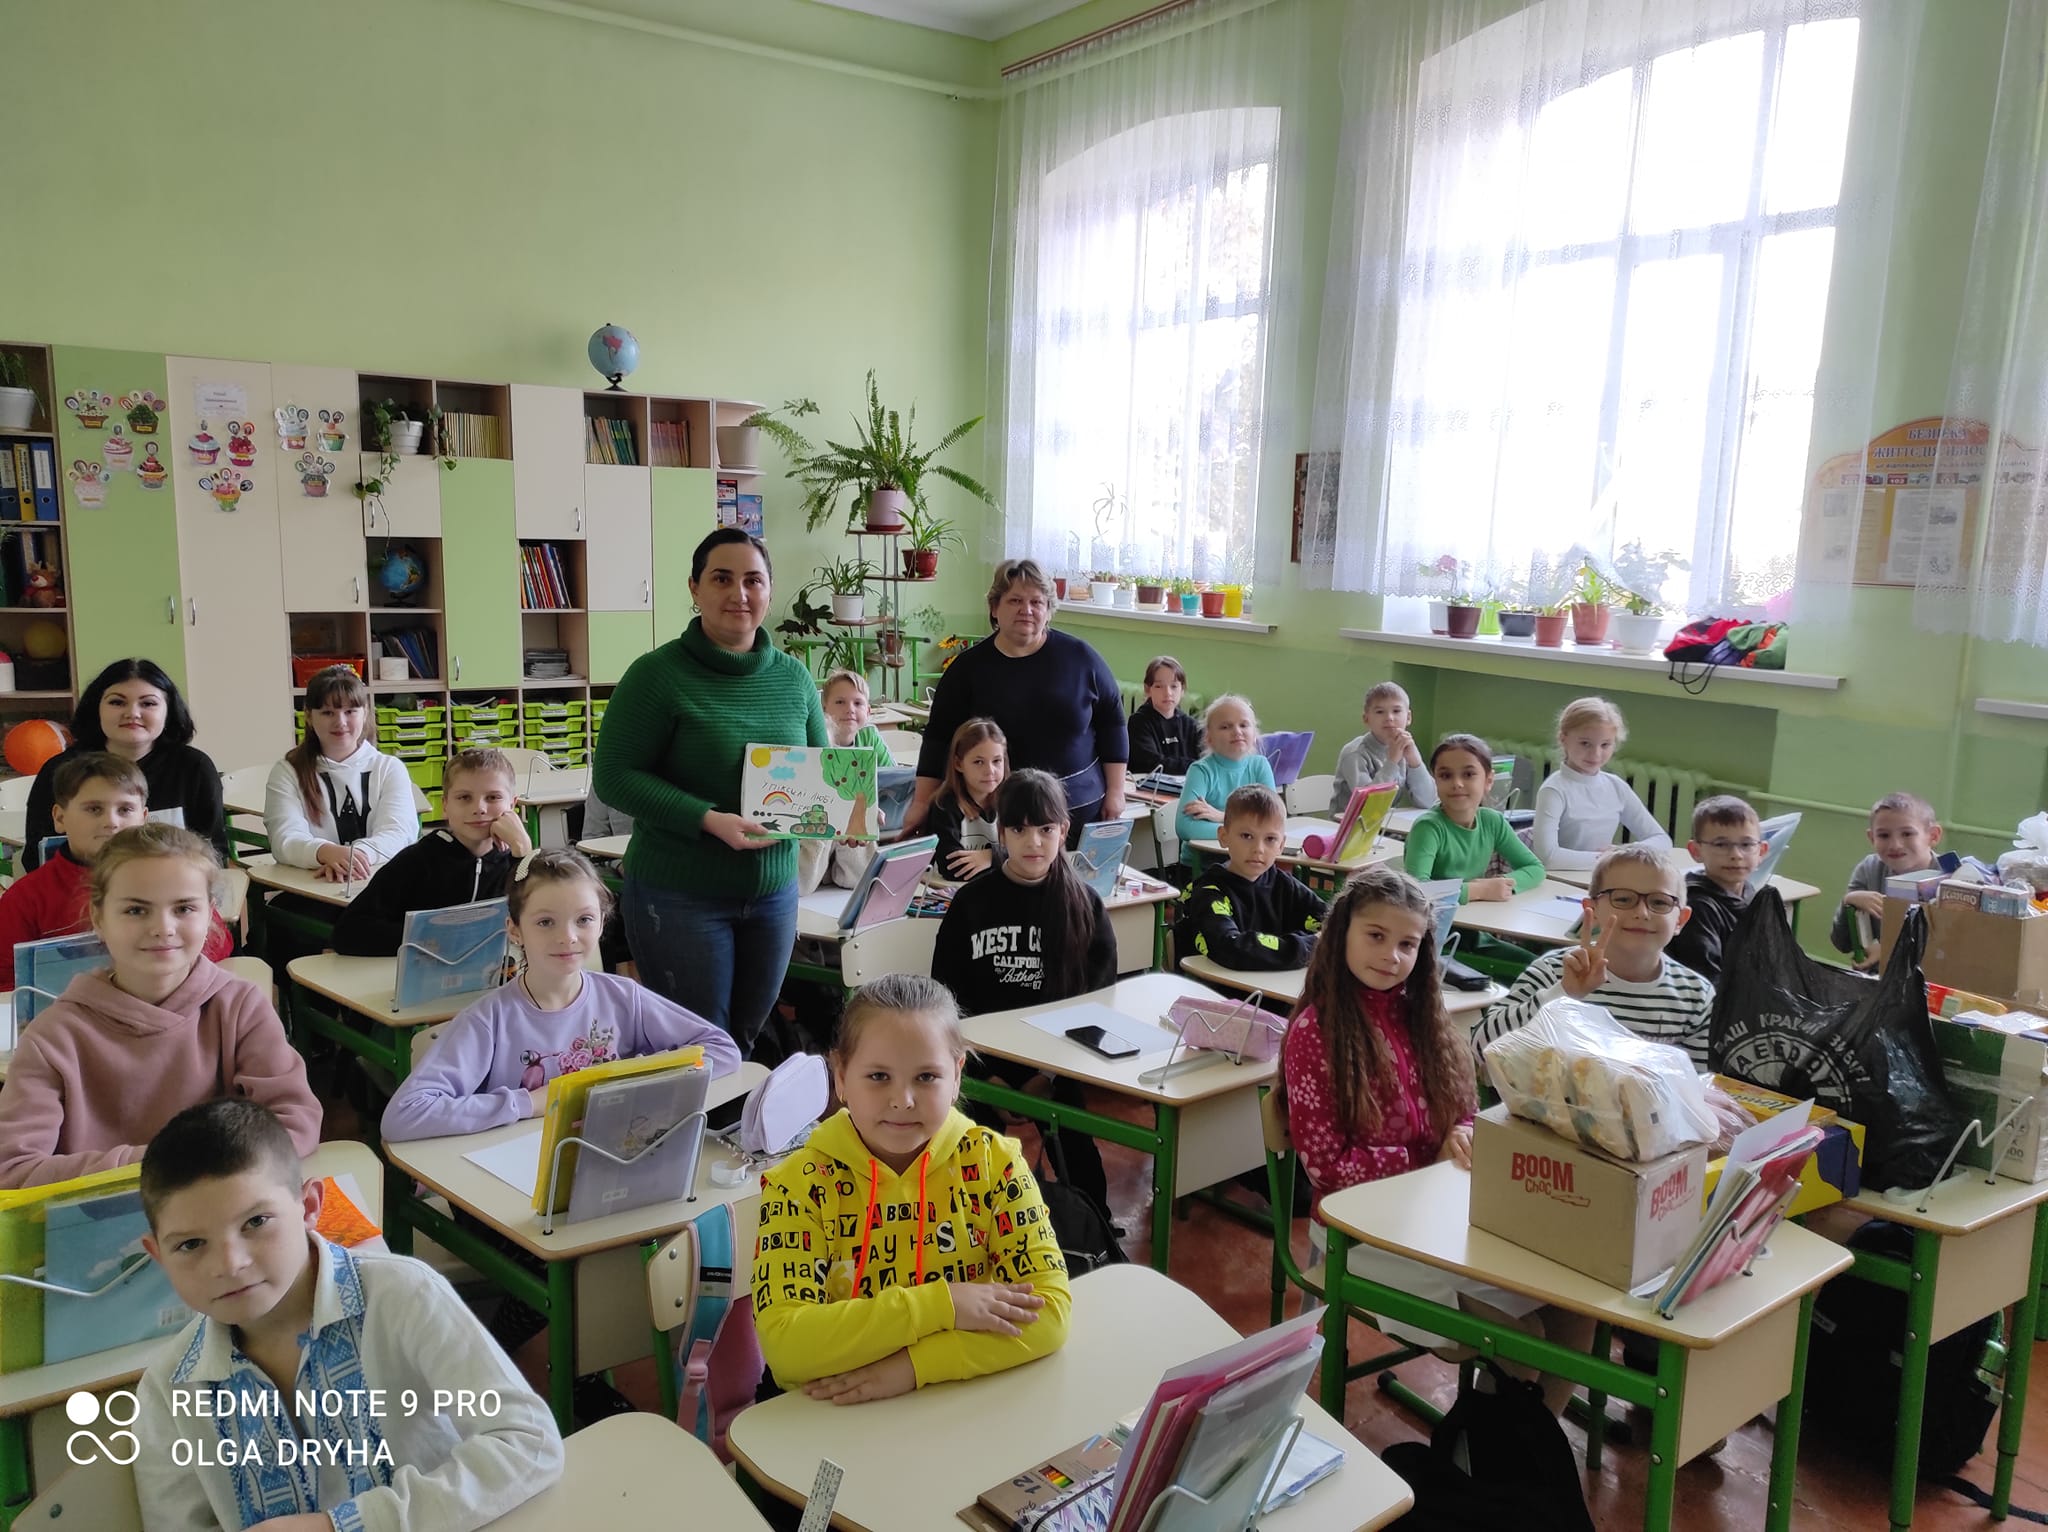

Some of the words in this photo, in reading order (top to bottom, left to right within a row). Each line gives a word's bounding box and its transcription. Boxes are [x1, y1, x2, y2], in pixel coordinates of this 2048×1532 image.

[971, 925, 1022, 960] WEST
[1511, 1152, 1575, 1193] BOOM
[1525, 1178, 1552, 1195] Choc
[1649, 1165, 1689, 1221] BOOM
